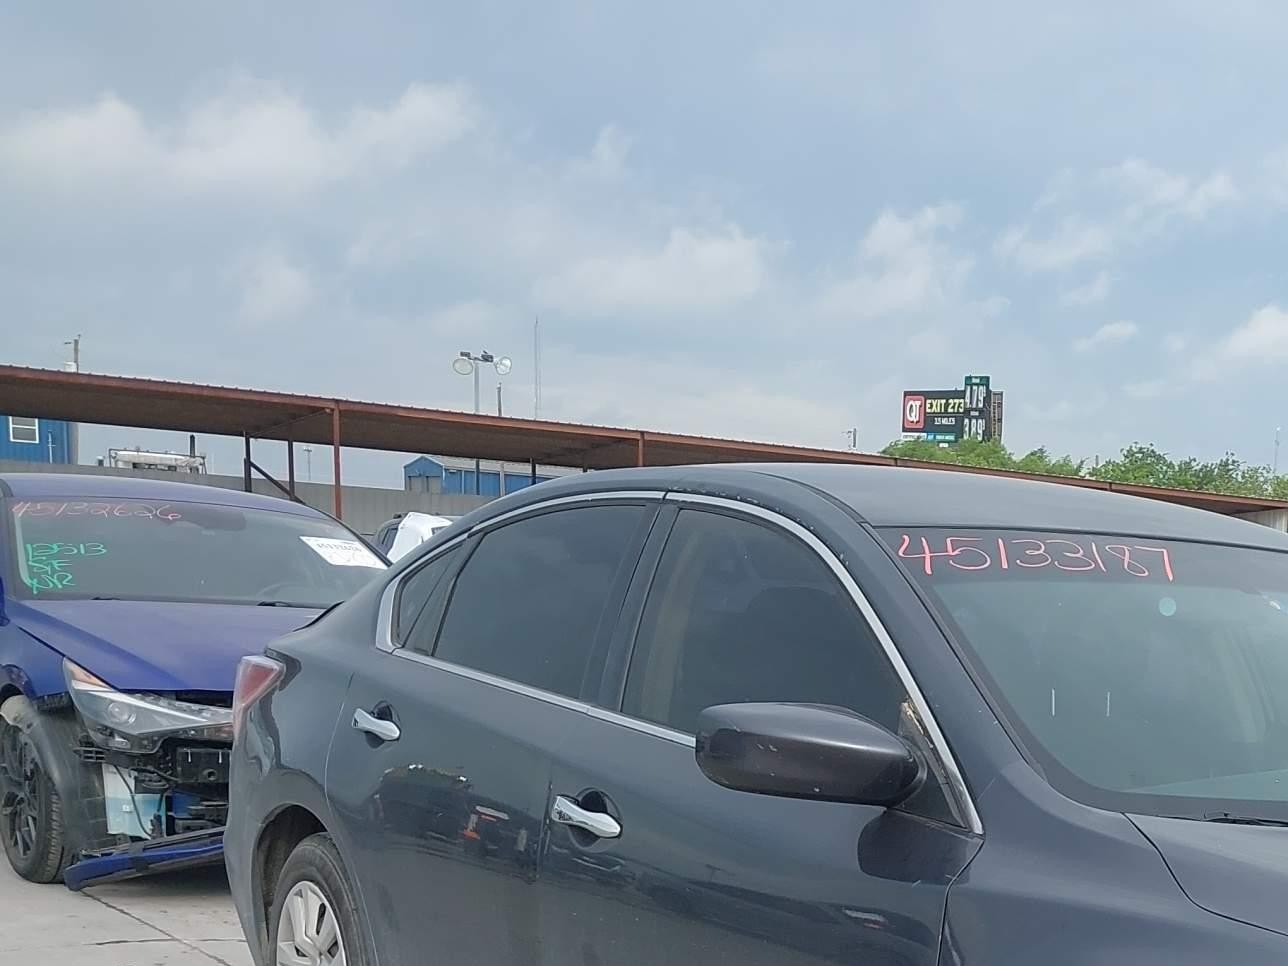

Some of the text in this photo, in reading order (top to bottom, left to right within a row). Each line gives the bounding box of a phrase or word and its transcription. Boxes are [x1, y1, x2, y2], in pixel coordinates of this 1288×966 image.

[906, 400, 921, 422] QT
[926, 399, 964, 413] EXIT 273
[12, 502, 182, 520] 45132626
[899, 534, 1173, 581] 45133187
